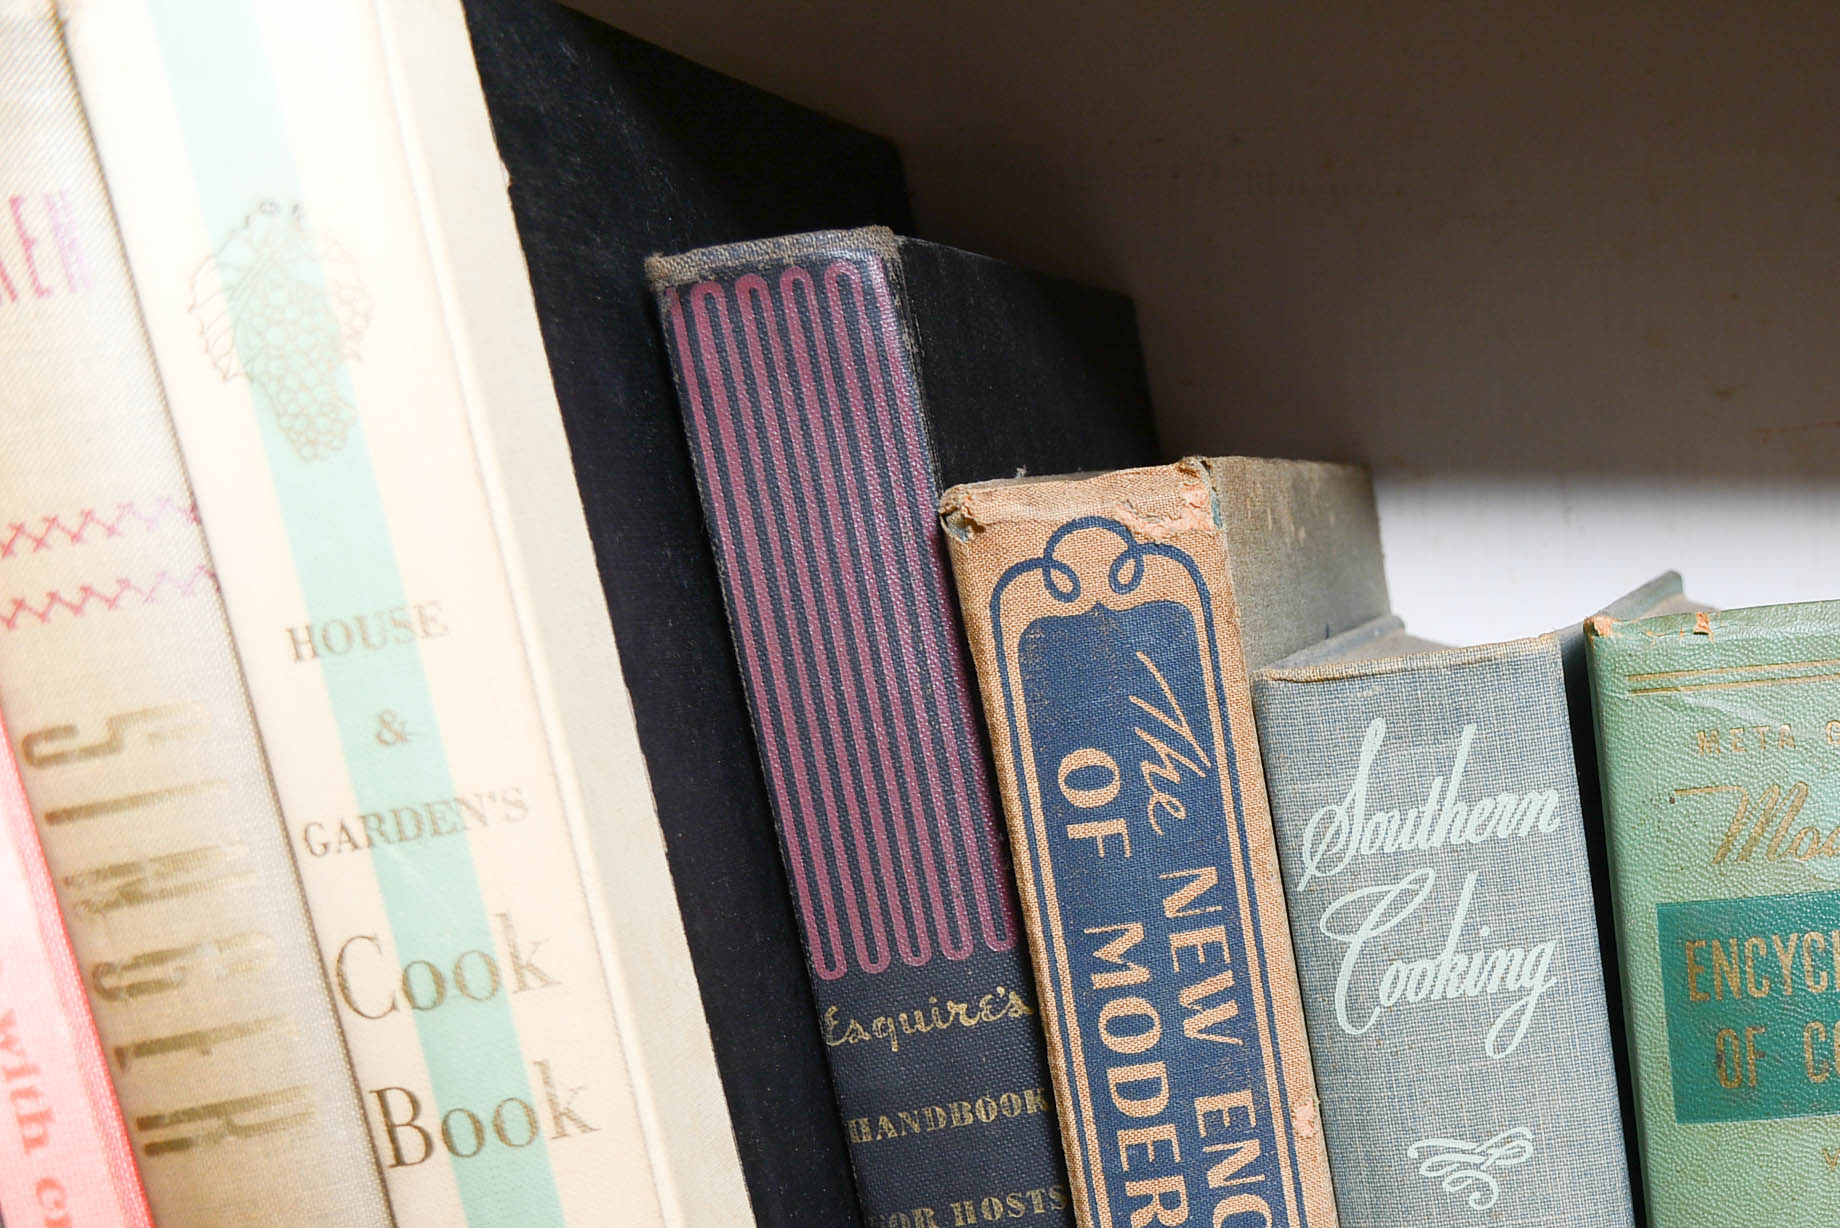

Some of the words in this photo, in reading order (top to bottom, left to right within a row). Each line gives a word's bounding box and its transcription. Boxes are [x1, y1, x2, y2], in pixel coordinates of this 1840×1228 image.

[285, 601, 449, 664] HOUSE
[375, 709, 412, 746] &
[1129, 651, 1211, 836] The
[1697, 723, 1797, 757] META
[303, 787, 529, 858] GARDEN'S
[1057, 747, 1132, 858] OF
[1297, 718, 1559, 892] Southern
[336, 912, 564, 1020] Cook
[1159, 865, 1245, 1045] NEW
[1320, 867, 1556, 1058] Cooking
[823, 986, 1036, 1052] Esquire's
[1715, 1026, 1766, 1089] OF
[369, 1059, 601, 1169] Book
[847, 1088, 1050, 1145] HANDBOOK
[951, 1185, 1068, 1227] HOSTS
